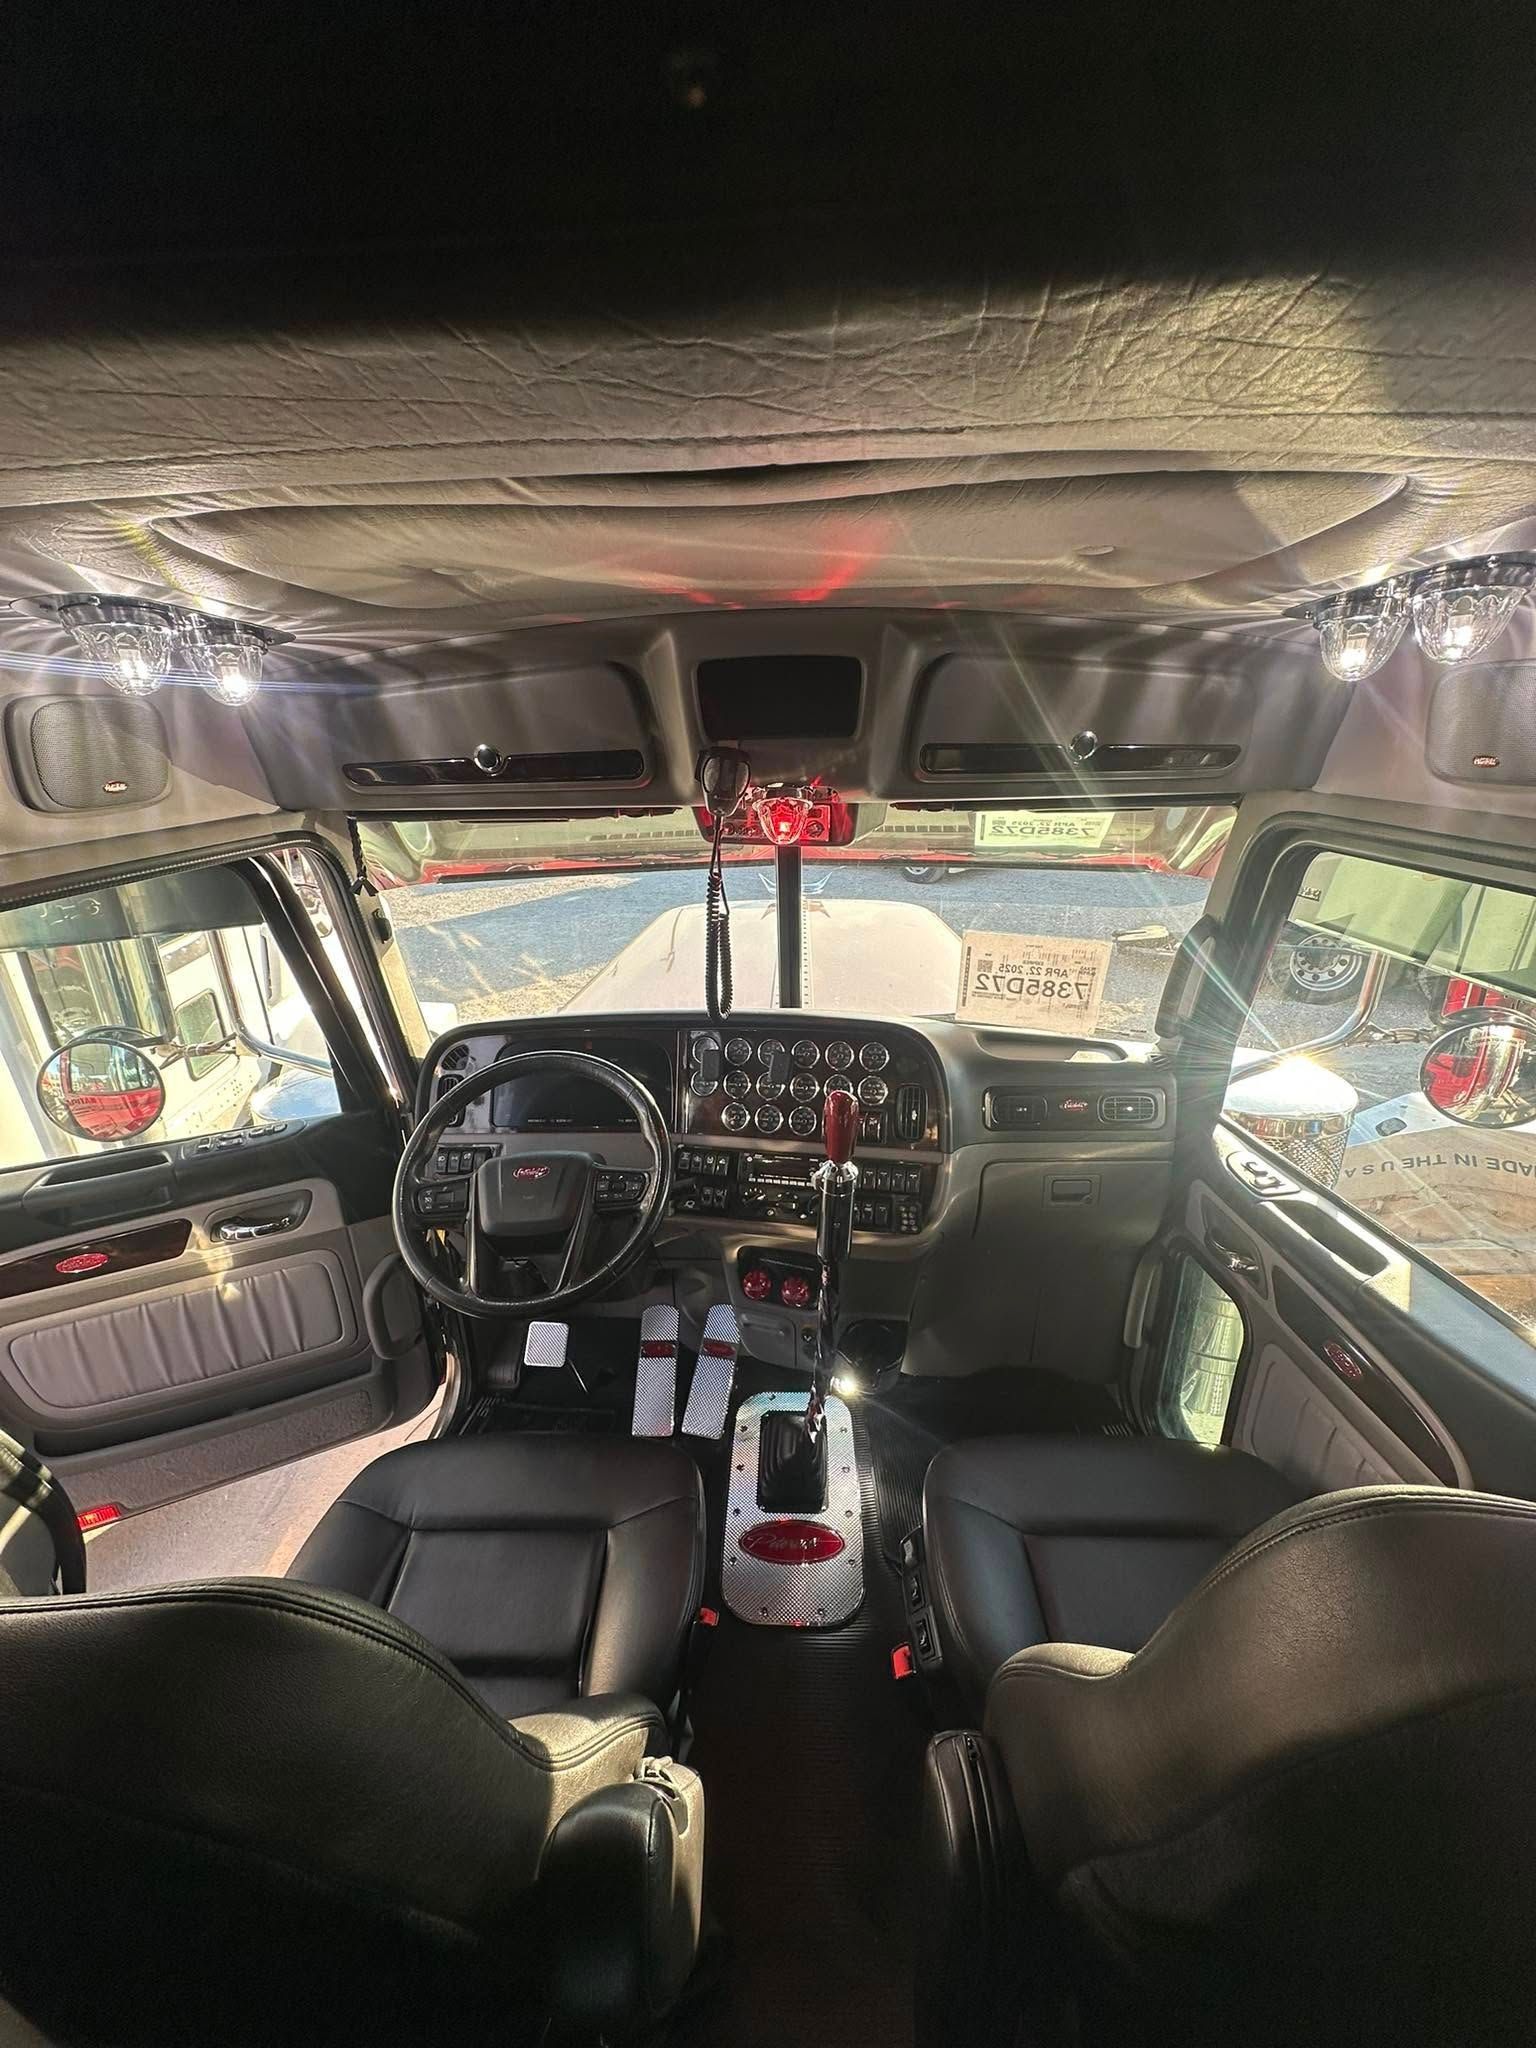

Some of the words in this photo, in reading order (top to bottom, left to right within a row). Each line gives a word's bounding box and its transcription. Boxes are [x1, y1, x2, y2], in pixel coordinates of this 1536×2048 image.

[1401, 1154, 1447, 1170] THE
[1454, 1152, 1478, 1168] IN
[1485, 1157, 1536, 1177] ADE
